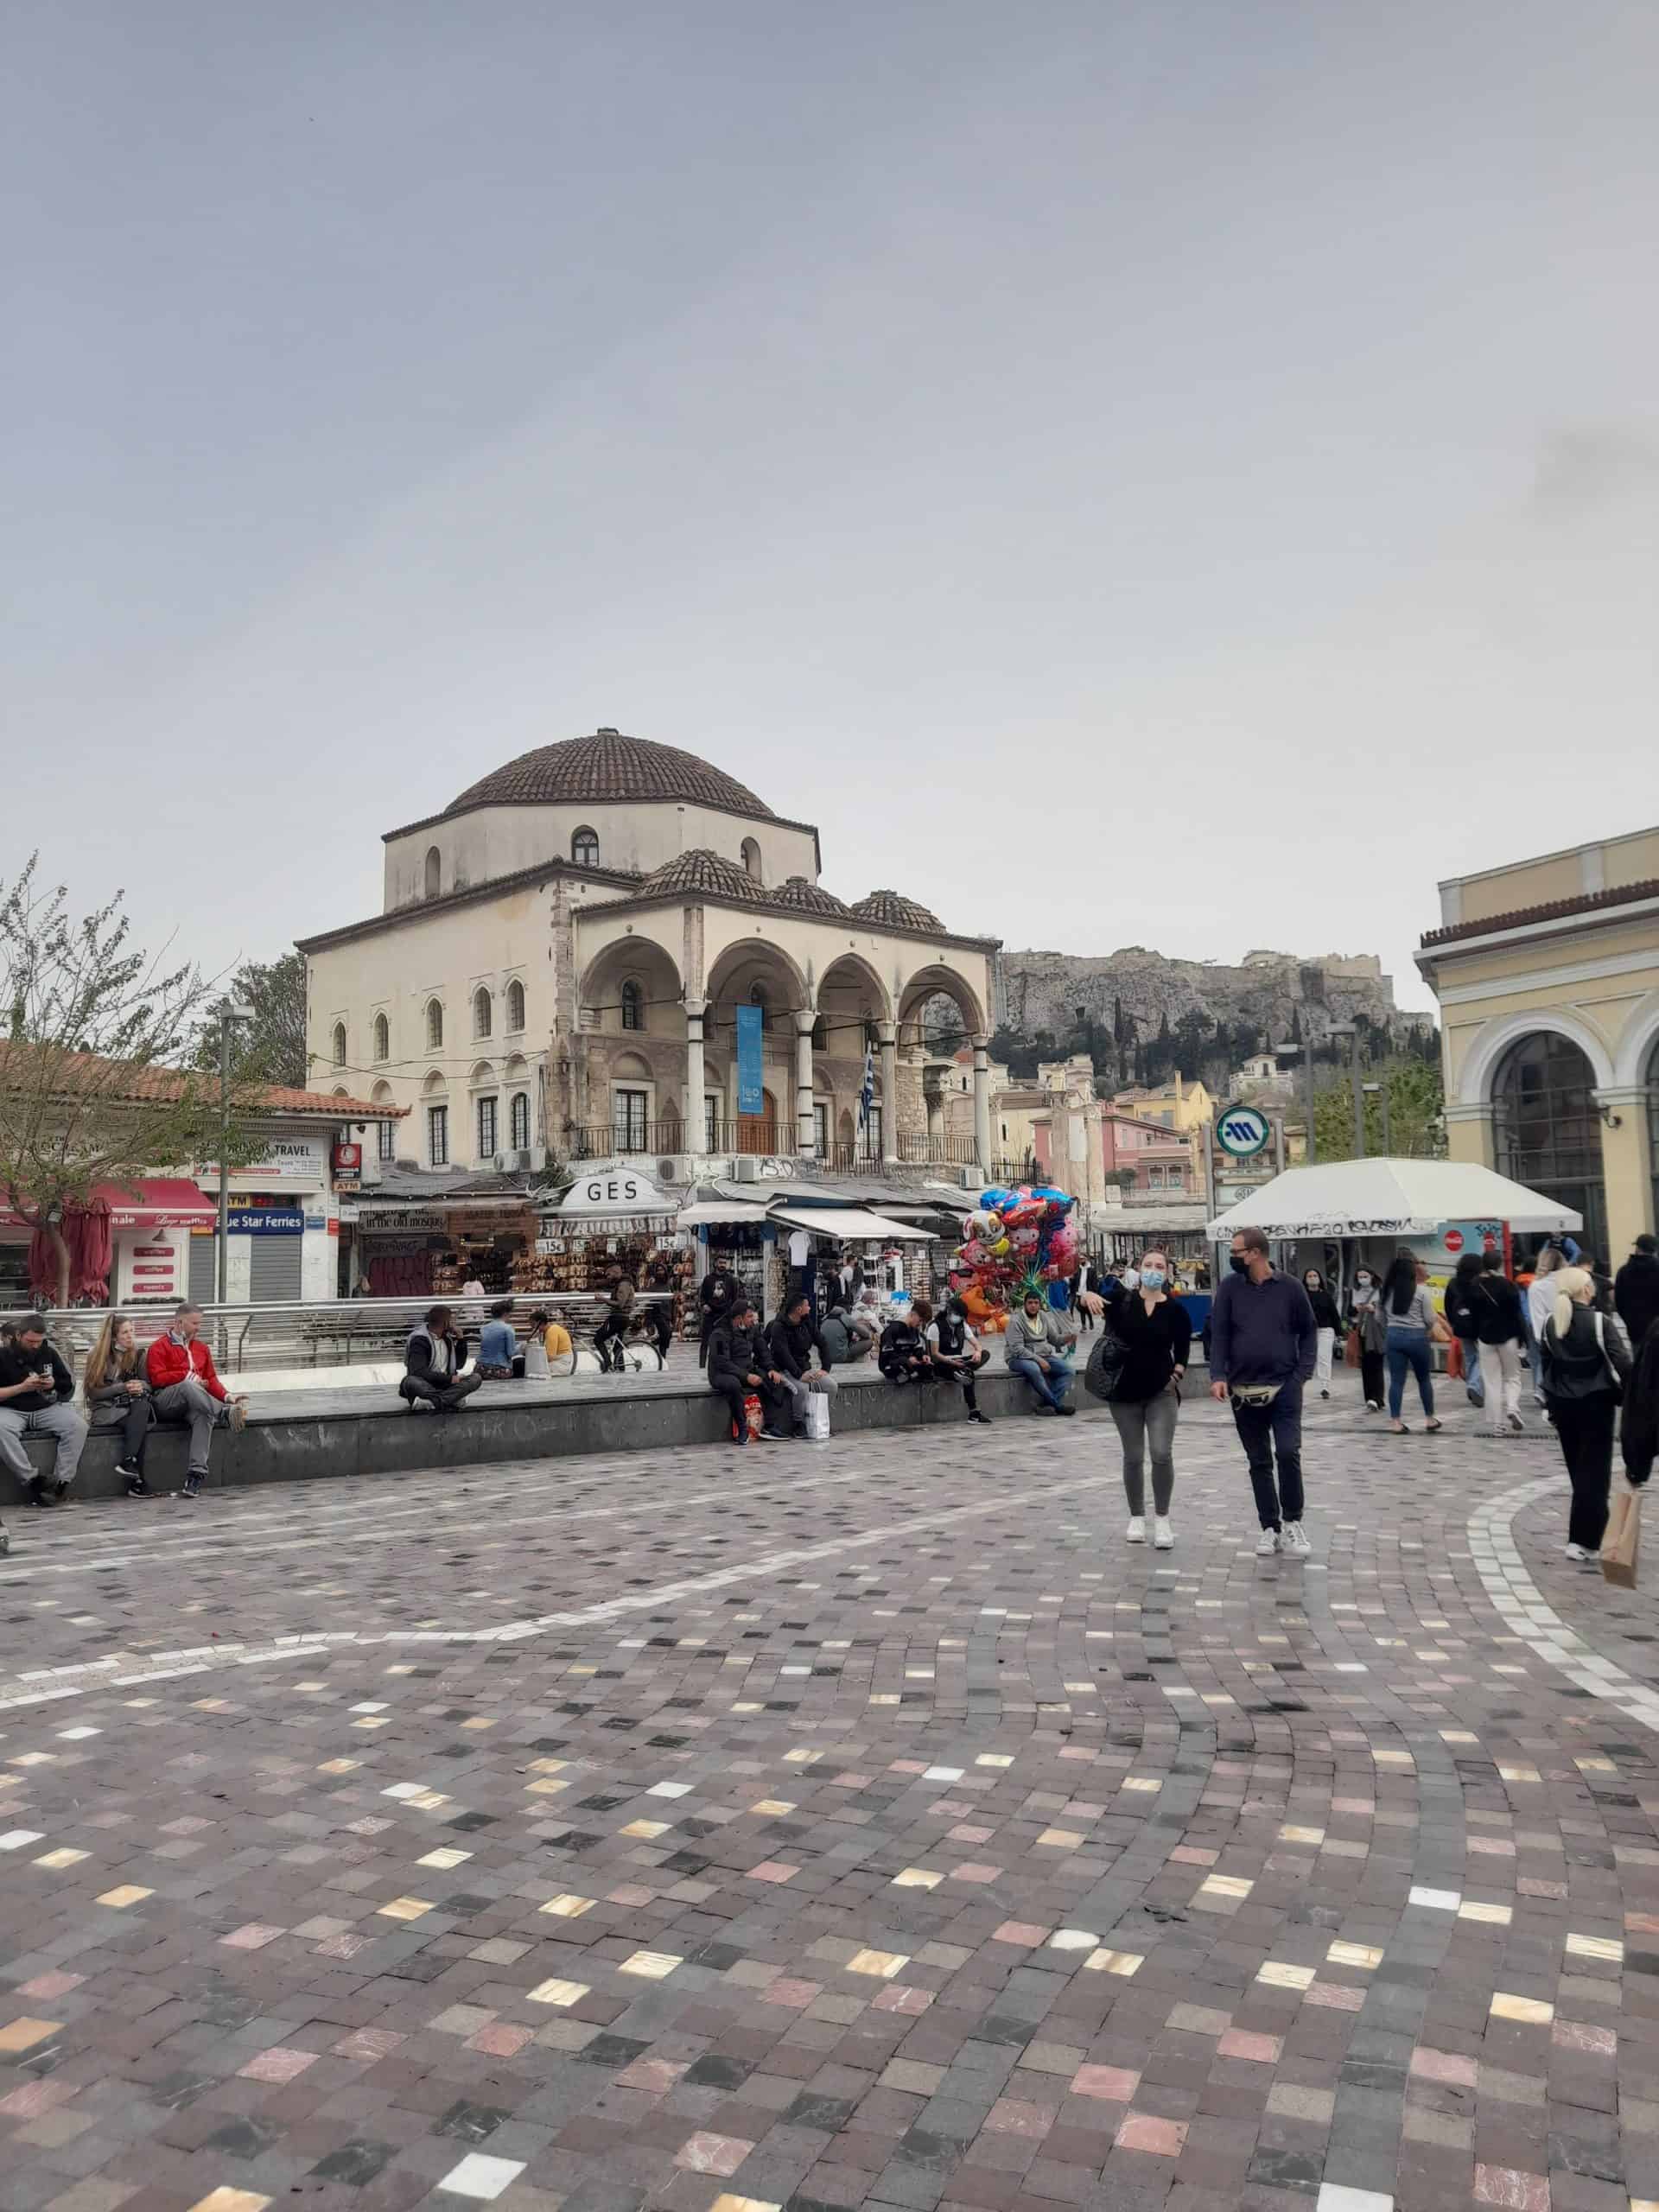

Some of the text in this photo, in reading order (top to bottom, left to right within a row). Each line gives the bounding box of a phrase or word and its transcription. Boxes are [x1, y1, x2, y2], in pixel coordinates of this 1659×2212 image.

[276, 1144, 311, 1156] TRAVEL
[588, 1181, 637, 1201] GES
[111, 1214, 136, 1224] nale
[216, 1216, 238, 1227] ue
[242, 1216, 264, 1227] Star
[265, 1216, 302, 1227] Ferries
